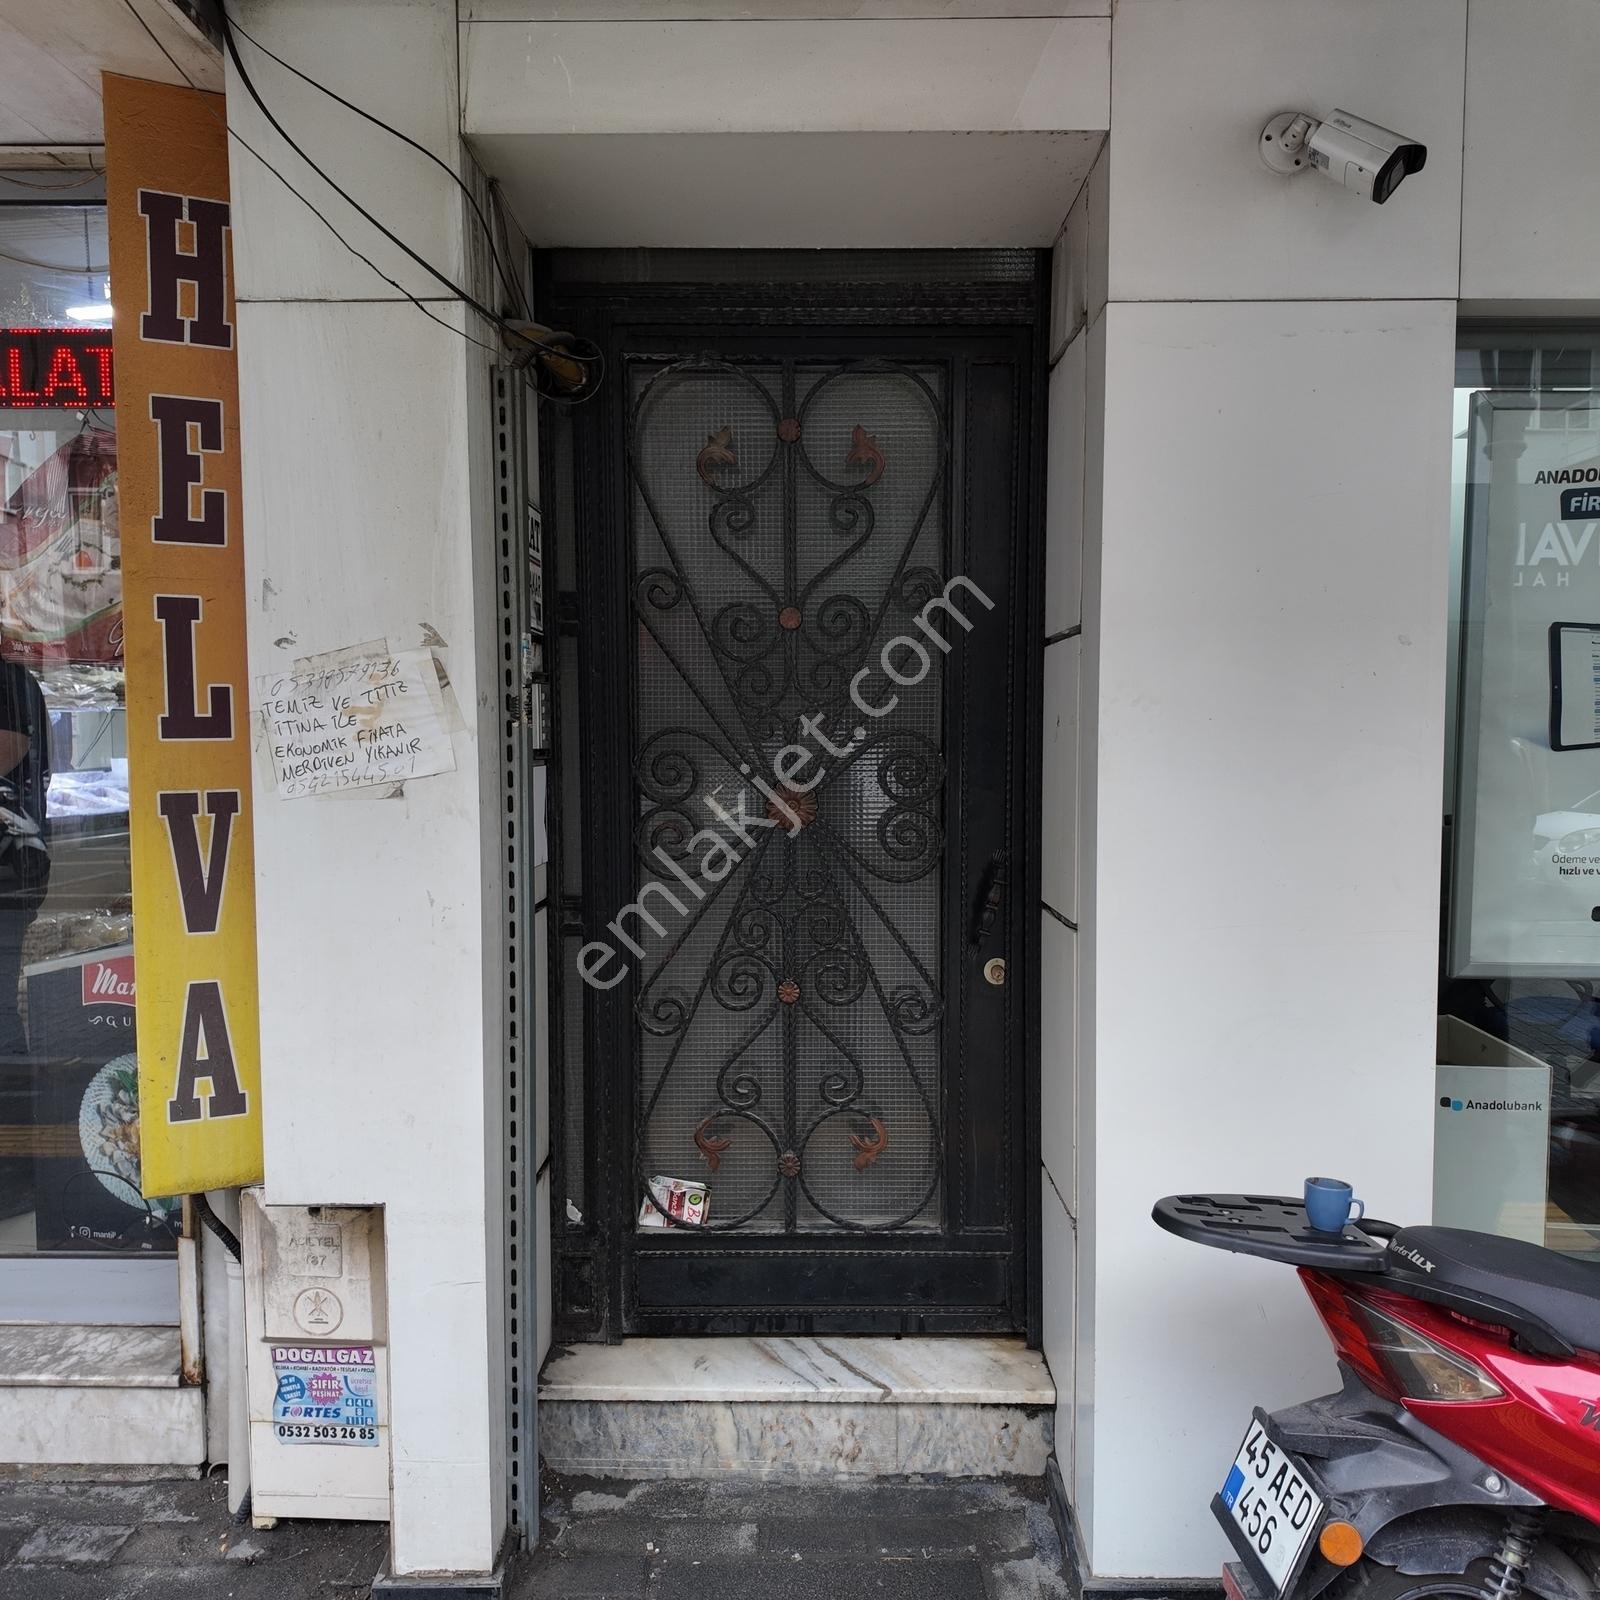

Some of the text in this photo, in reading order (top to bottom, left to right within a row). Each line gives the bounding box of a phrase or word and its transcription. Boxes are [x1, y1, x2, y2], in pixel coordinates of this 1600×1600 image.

[0, 348, 113, 397] LAT
[1534, 468, 1600, 485] ANADO
[137, 187, 247, 1124] HELVA
[331, 696, 351, 711] VE
[1466, 1100, 1542, 1111] Anadolubank
[312, 1379, 339, 1390] SIFIR
[278, 1426, 375, 1440] 0532 503 26 85
[1245, 1430, 1313, 1530] 45 AED
[1238, 1486, 1277, 1554] 456
